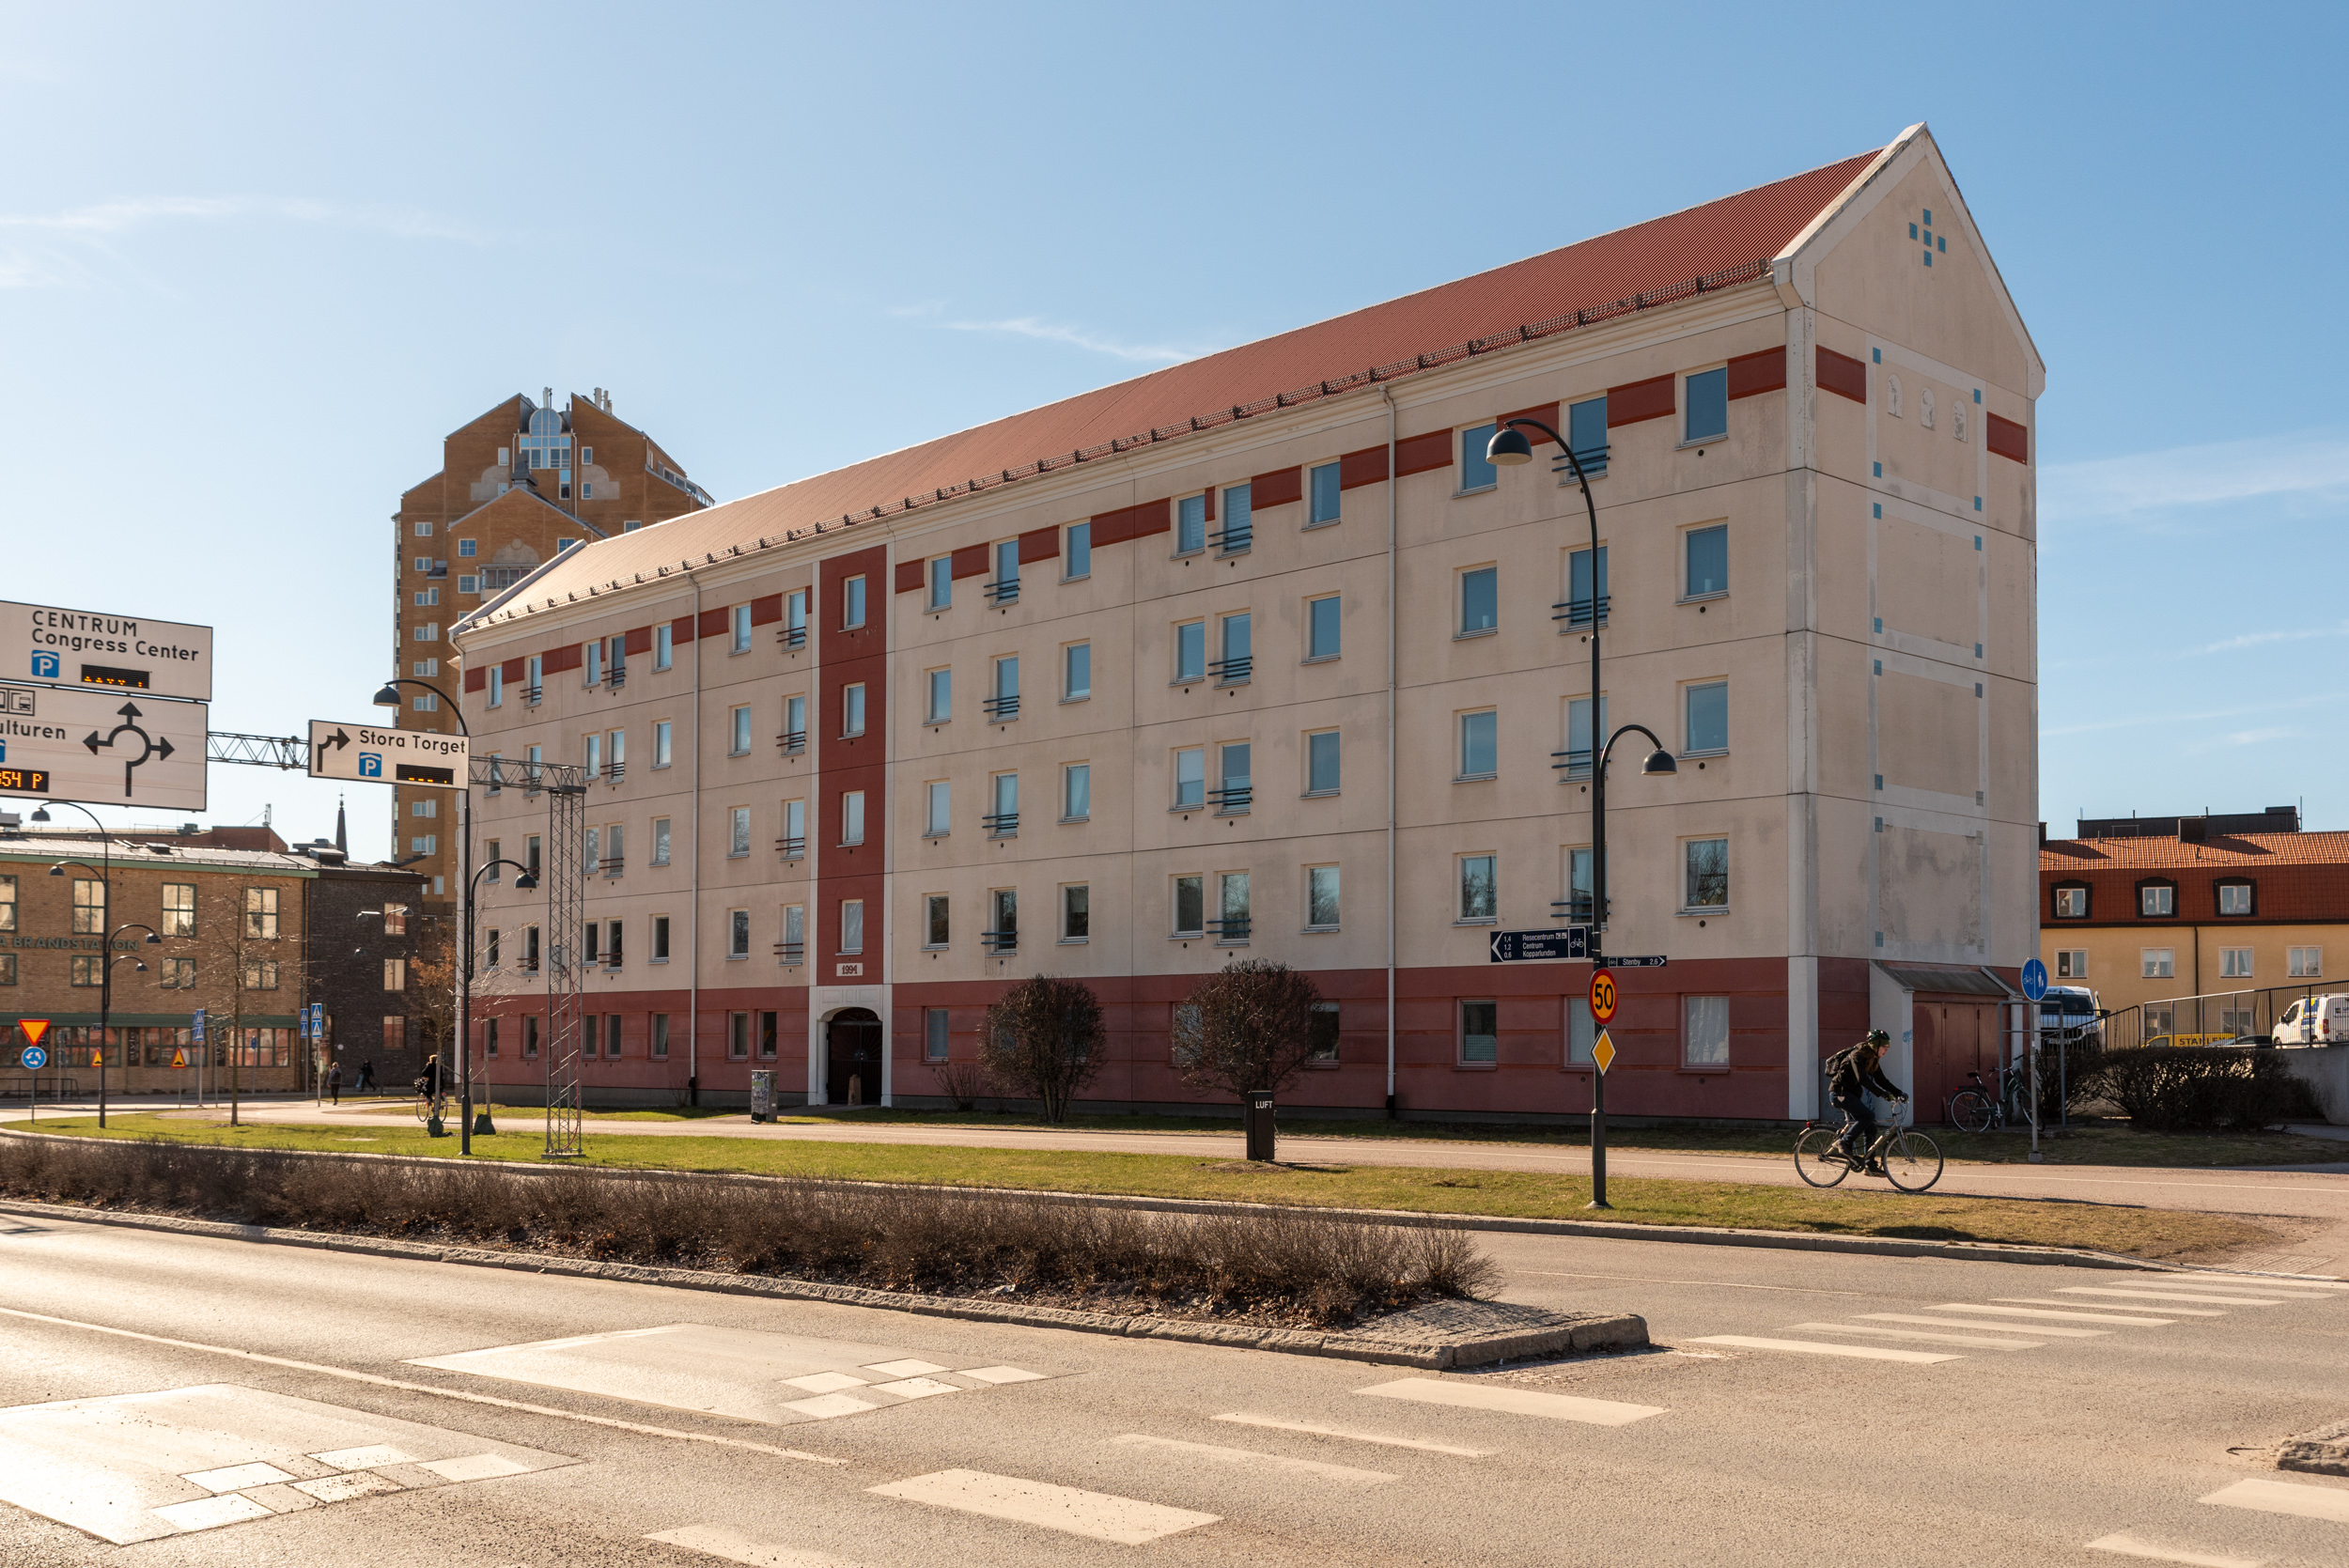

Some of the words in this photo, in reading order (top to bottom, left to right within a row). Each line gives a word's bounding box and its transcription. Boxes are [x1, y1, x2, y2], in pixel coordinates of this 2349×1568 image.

[32, 610, 137, 637] CENTRUM
[32, 629, 128, 654] Congress
[135, 641, 199, 661] Center
[360, 730, 405, 748] Stora
[412, 735, 465, 755] Torget
[0, 770, 22, 787] 54
[13, 937, 139, 951] BRANDSTAON
[1522, 950, 1556, 958] Kopparlunden
[1623, 957, 1641, 967] Stenby
[842, 965, 857, 974] 1994
[1595, 984, 1614, 1010] 50
[2179, 1037, 2225, 1046] STANLE
[1255, 1100, 1273, 1110] LUFT
